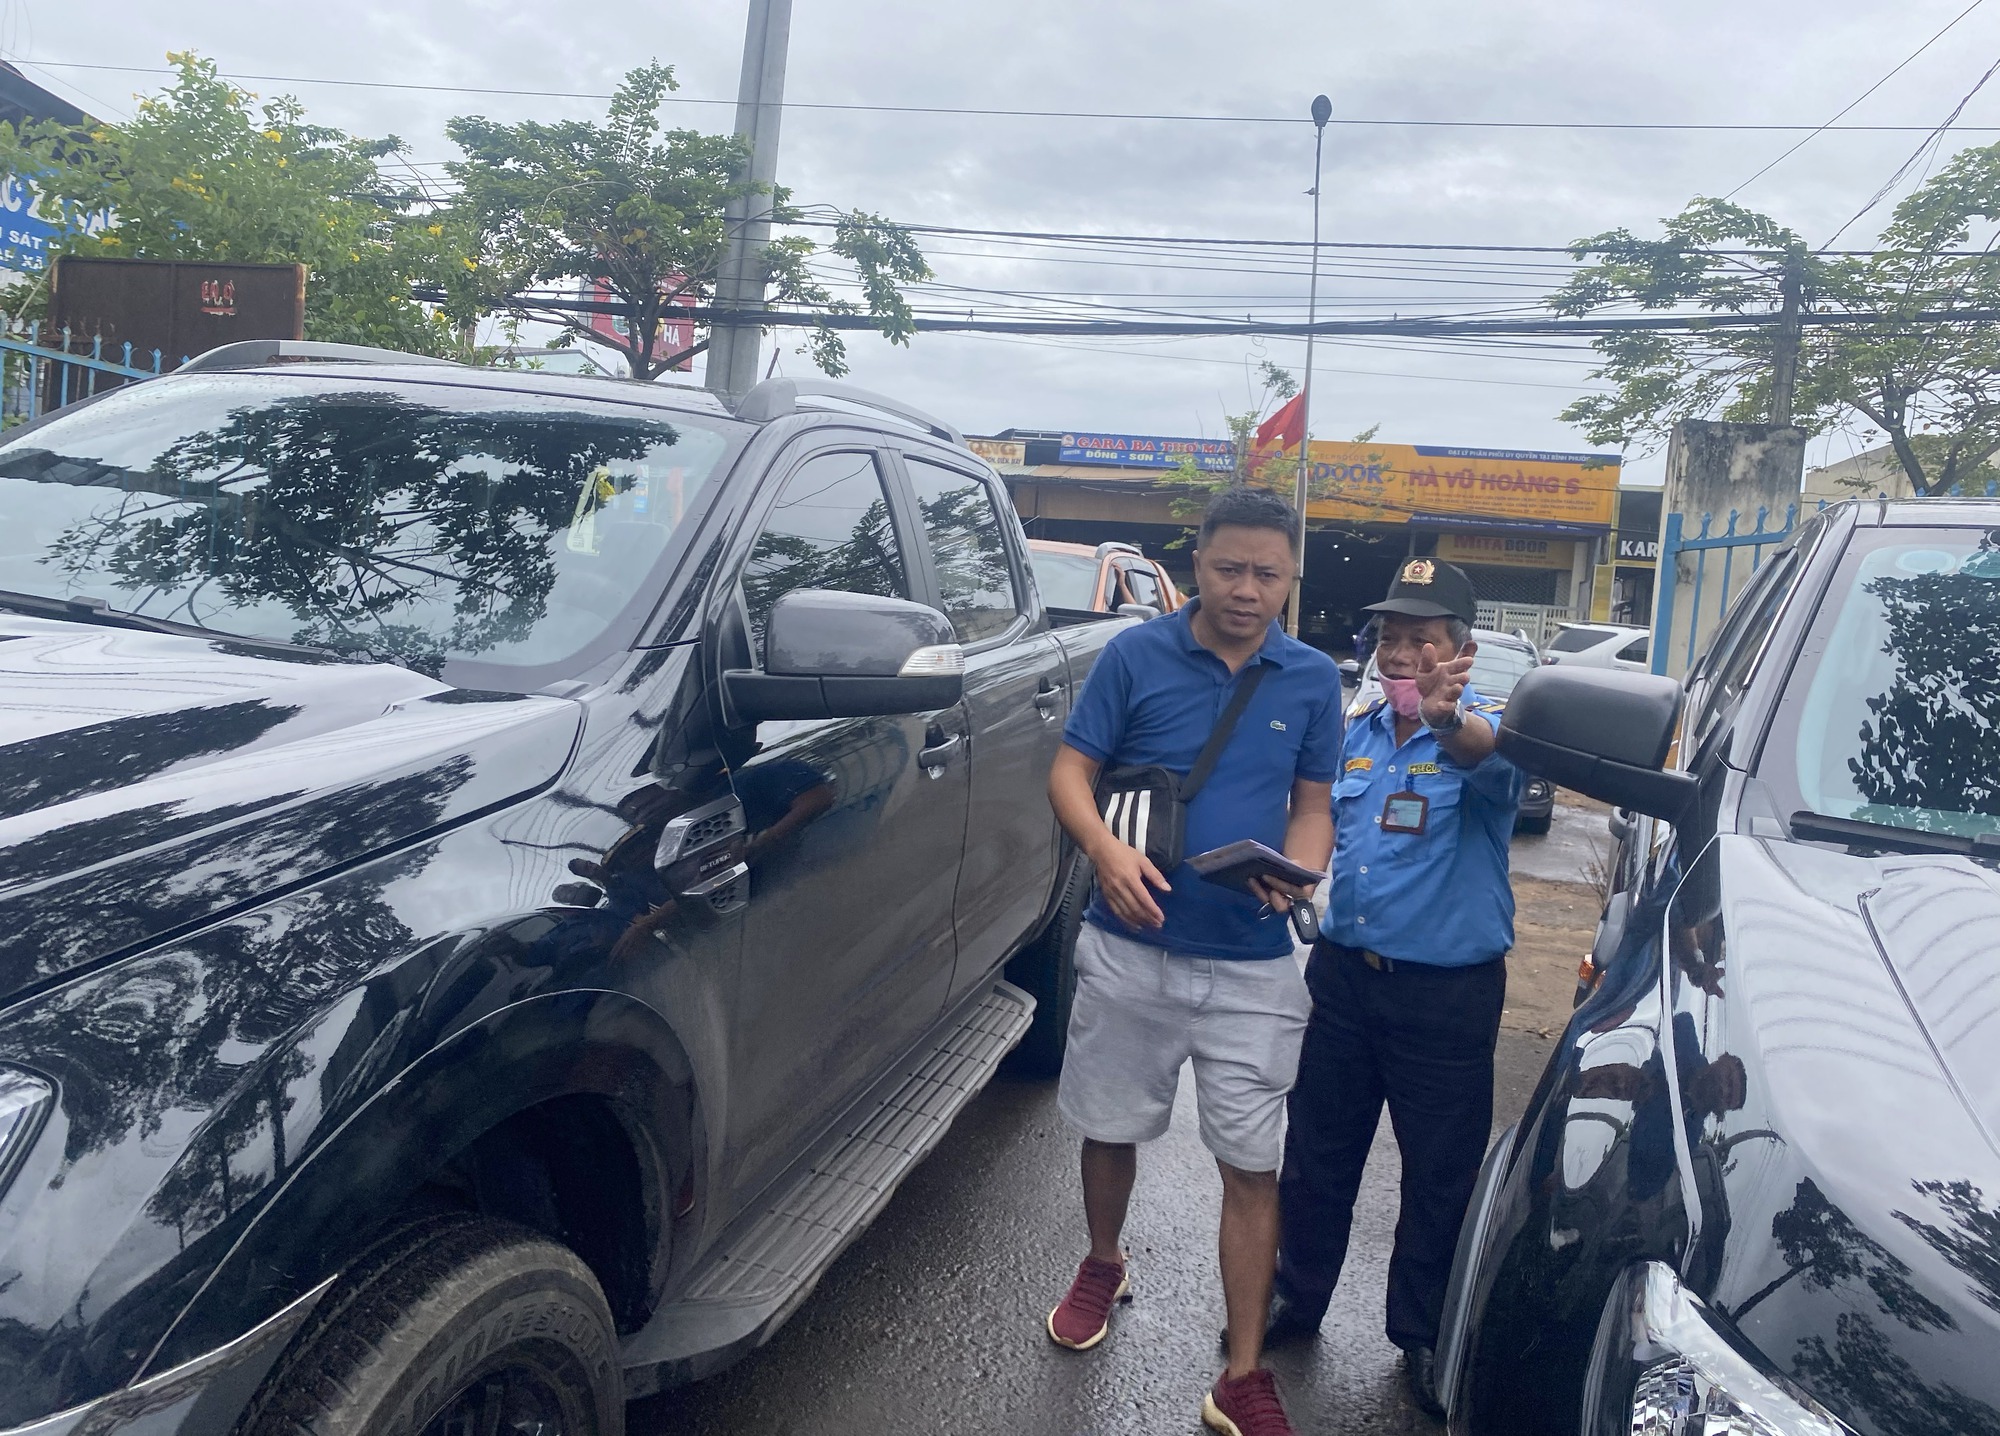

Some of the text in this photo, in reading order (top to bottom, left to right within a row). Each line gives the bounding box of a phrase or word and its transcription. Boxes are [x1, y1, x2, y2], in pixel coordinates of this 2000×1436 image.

[8, 230, 43, 250] SÁT
[1076, 436, 1127, 450] GARA
[1131, 439, 1155, 452] BA
[1129, 453, 1153, 461] SƠN
[1539, 453, 1550, 461] TẠI
[1409, 465, 1580, 495] HÀ VŨ HOÀNG S
[1620, 540, 1658, 558] KAR
